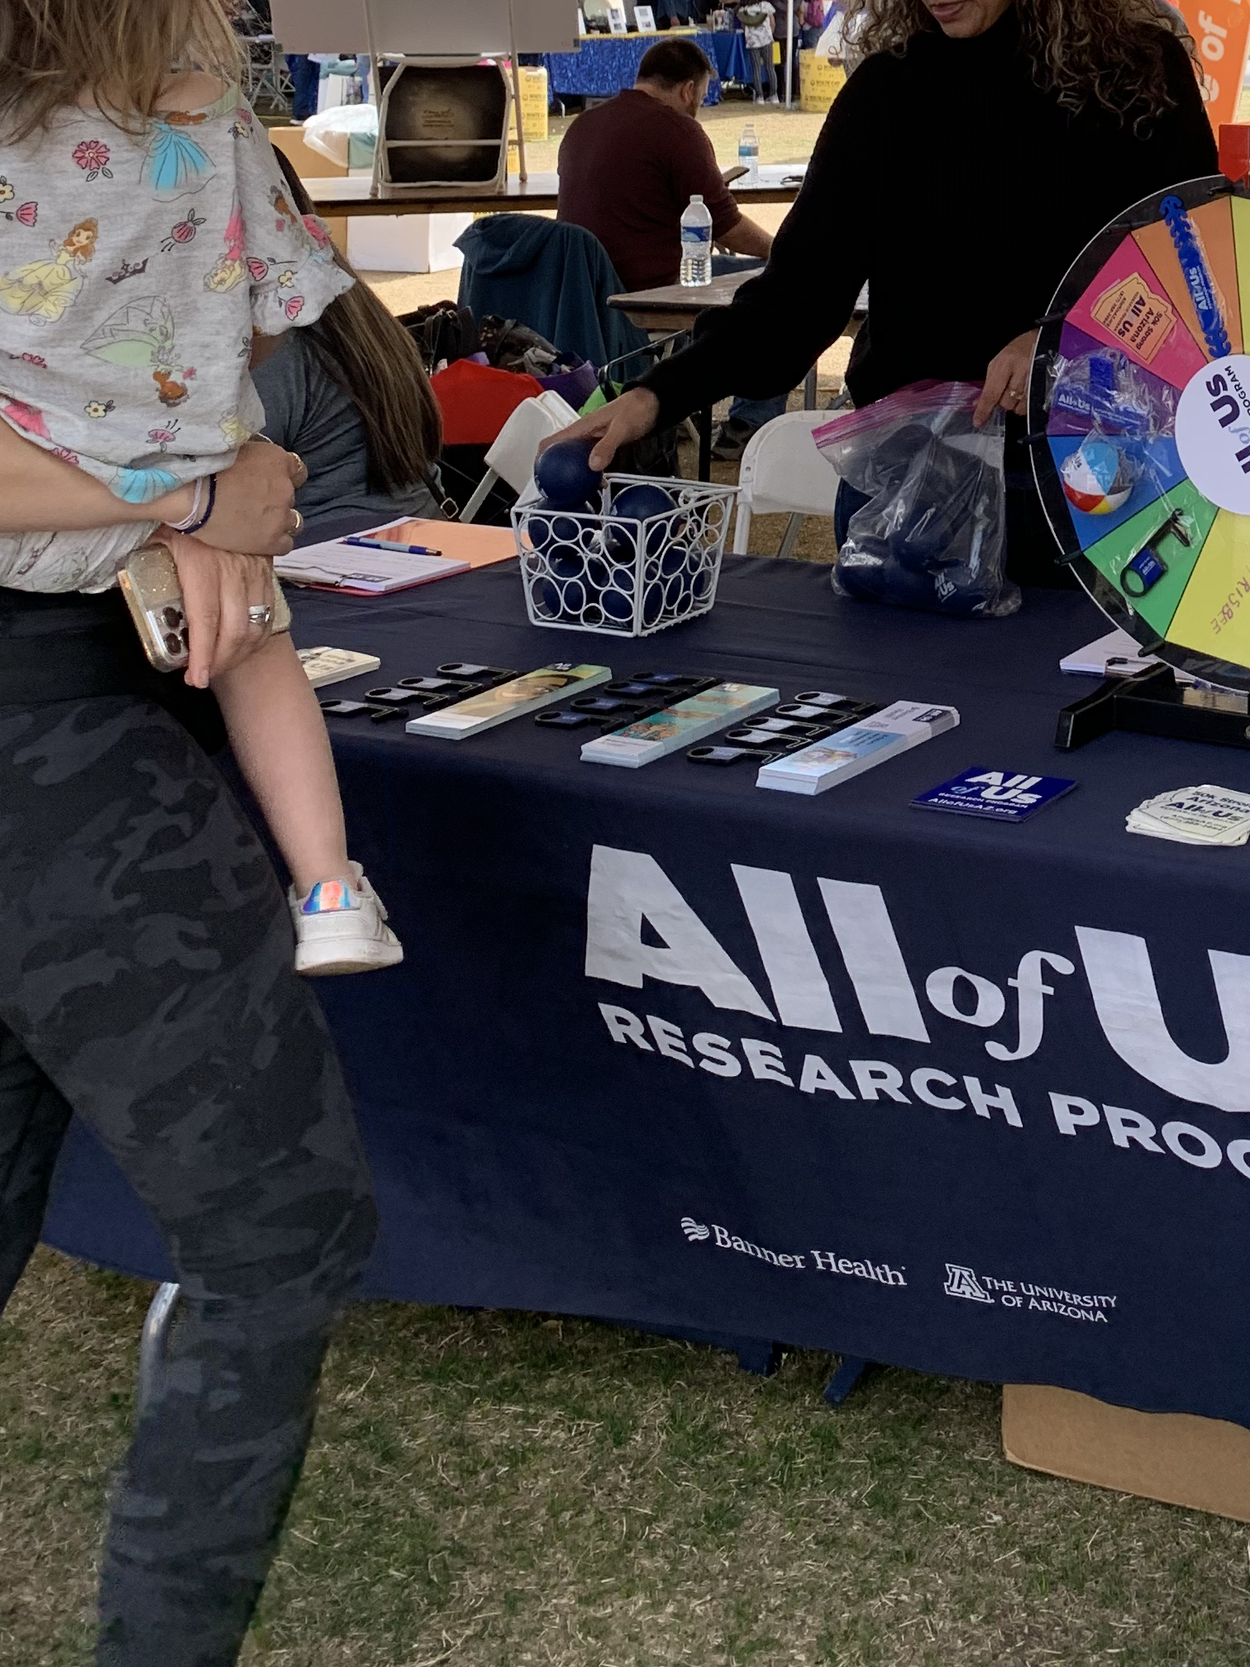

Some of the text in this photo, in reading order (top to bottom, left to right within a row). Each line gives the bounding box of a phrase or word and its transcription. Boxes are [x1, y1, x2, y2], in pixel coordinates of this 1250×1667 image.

[1198, 10, 1228, 62] of
[1116, 295, 1148, 338] All Us
[1129, 307, 1155, 343] Arizona
[1134, 325, 1154, 350] Strong
[1205, 374, 1240, 428] Us
[964, 771, 1043, 790] All
[980, 785, 1042, 804] Us
[927, 798, 1018, 815] AllofUsAZ.org
[1165, 802, 1200, 812] All
[1212, 810, 1244, 822] Us
[1186, 797, 1250, 814] Arizona
[585, 844, 930, 1043] All
[925, 950, 1075, 1061] of
[598, 1002, 1023, 1128] RESEARCH
[711, 1224, 907, 1287] Banner Health
[982, 1276, 1117, 1310] THE UNIVERSITY
[1001, 1294, 1109, 1324] OF ARIZONA
